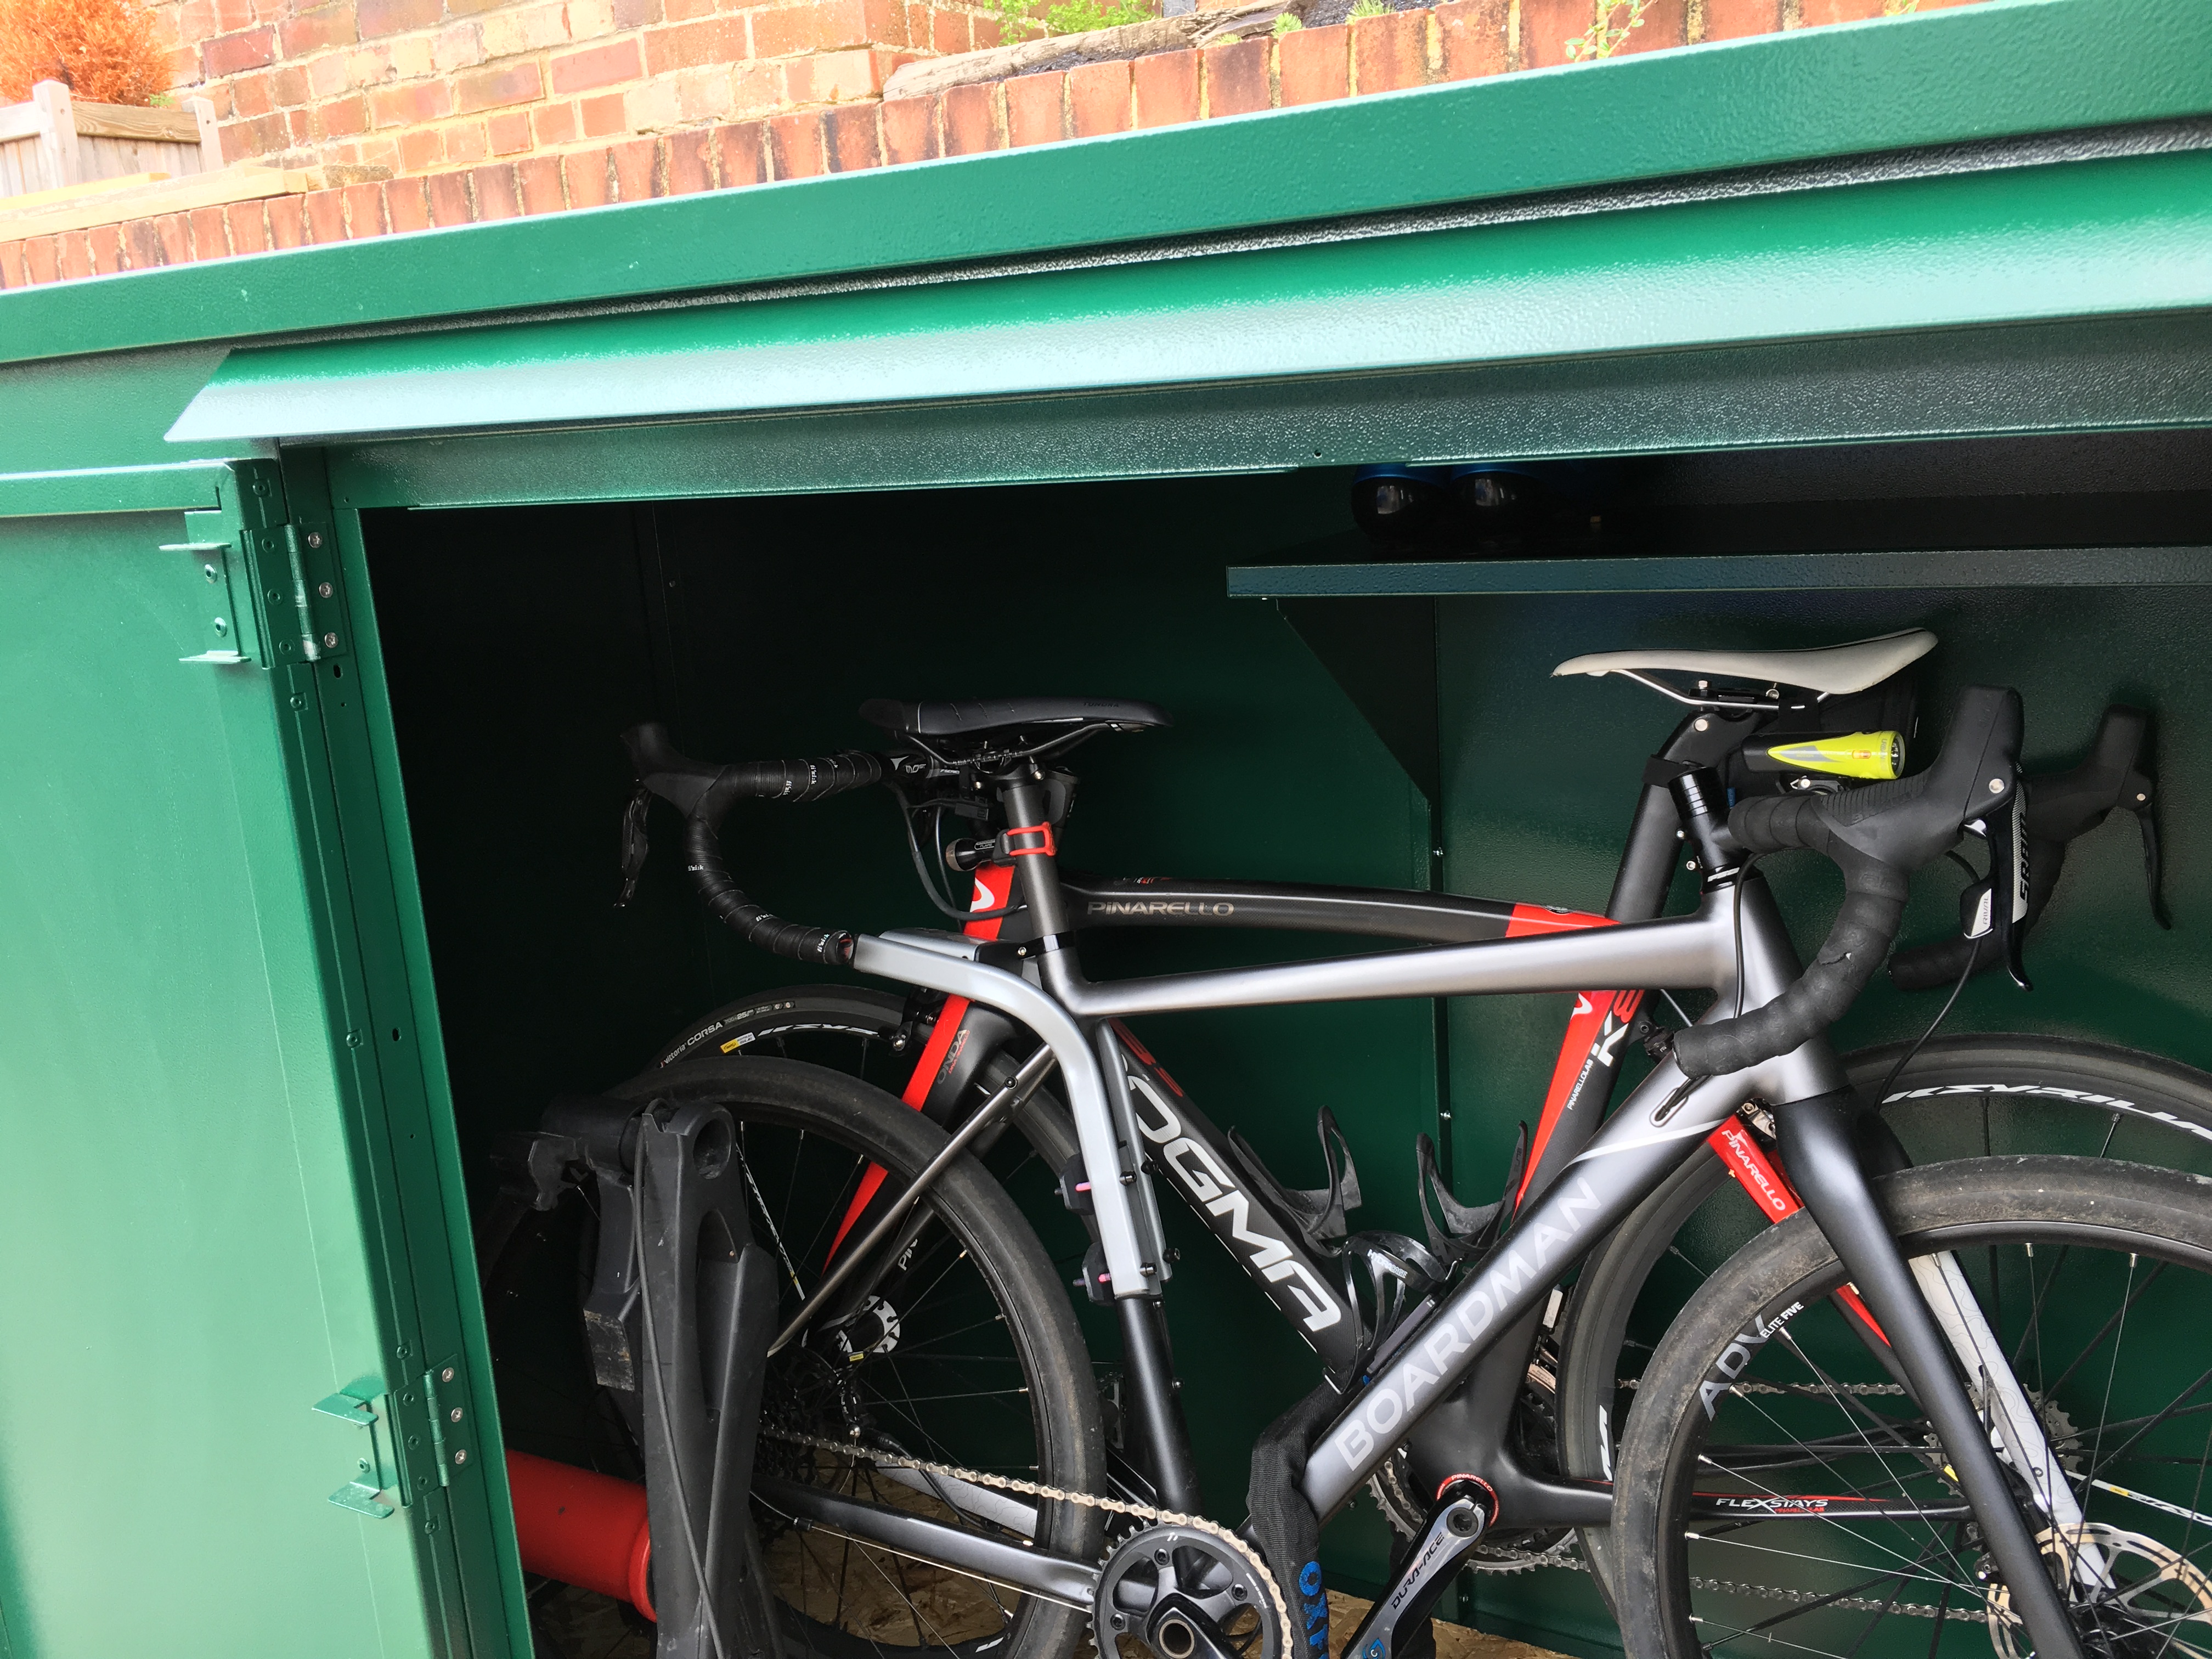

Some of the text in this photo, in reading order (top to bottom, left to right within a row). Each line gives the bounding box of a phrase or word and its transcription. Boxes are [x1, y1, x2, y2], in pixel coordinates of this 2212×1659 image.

[687, 1022, 724, 1046] CORSA
[937, 1029, 968, 1085] ONDA
[1121, 1053, 1341, 1332] OGMA
[1335, 1177, 1601, 1471] BOARDMAN
[1760, 1301, 1804, 1339] ELITE FIVE
[1699, 1314, 1769, 1422] ADV
[1451, 1474, 1493, 1492] PINARELLO
[1299, 1561, 1329, 1659] OXF
[1391, 1532, 1444, 1610] DURA-ACE
